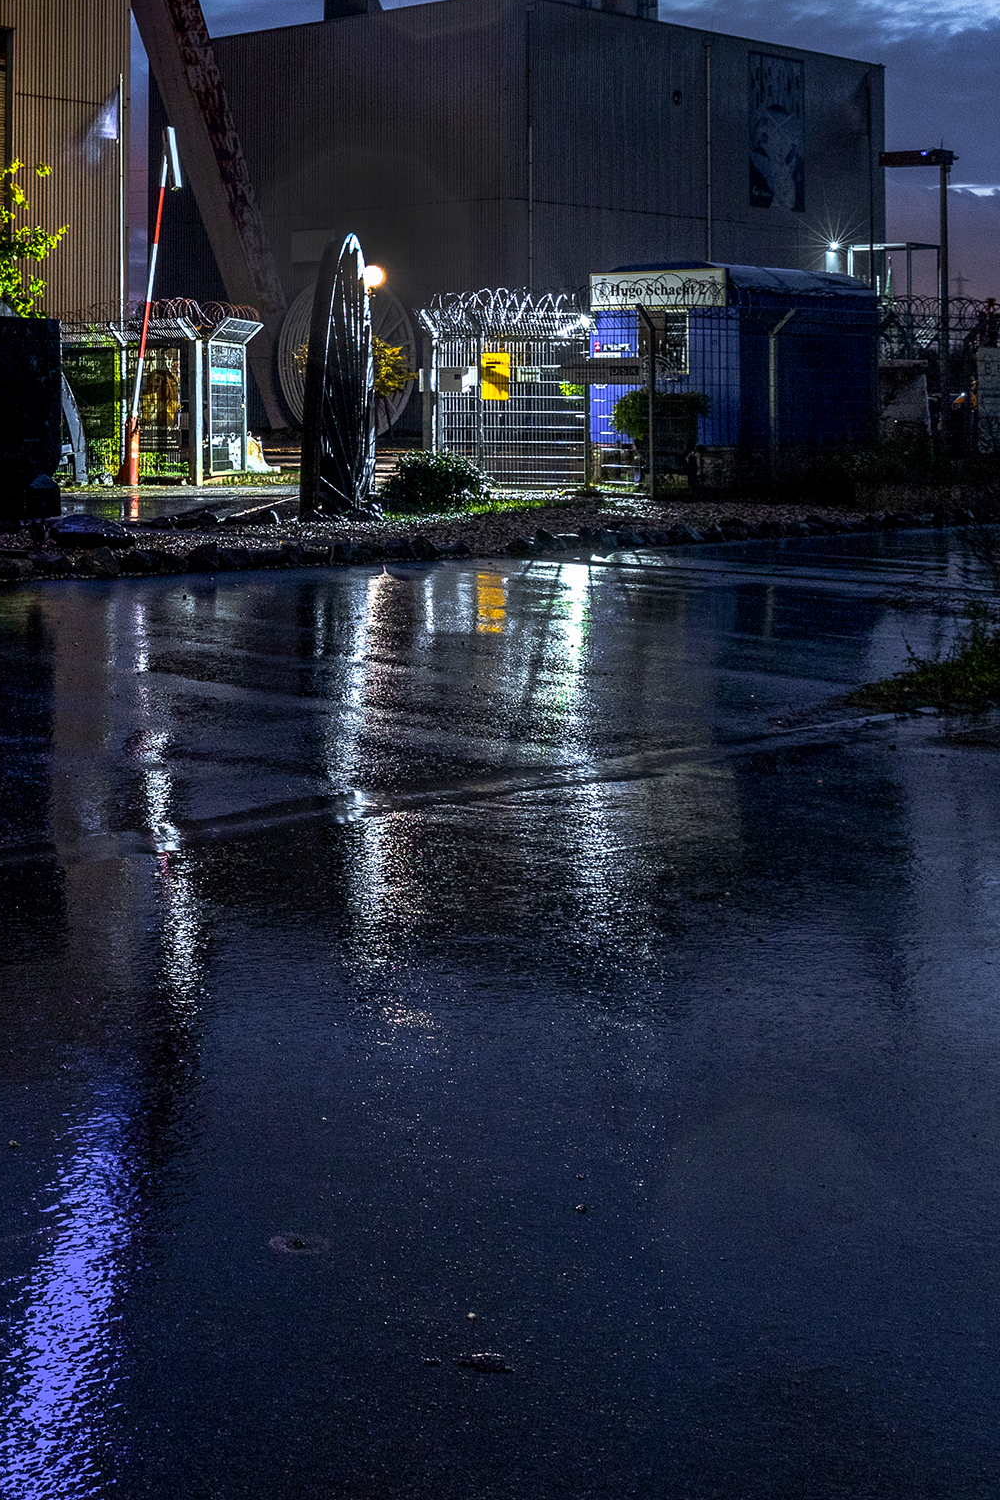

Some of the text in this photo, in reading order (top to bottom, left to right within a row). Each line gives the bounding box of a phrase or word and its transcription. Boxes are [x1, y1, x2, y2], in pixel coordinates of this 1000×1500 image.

[611, 283, 706, 298] Hugo Schacht 2
[610, 366, 639, 376] DSK
